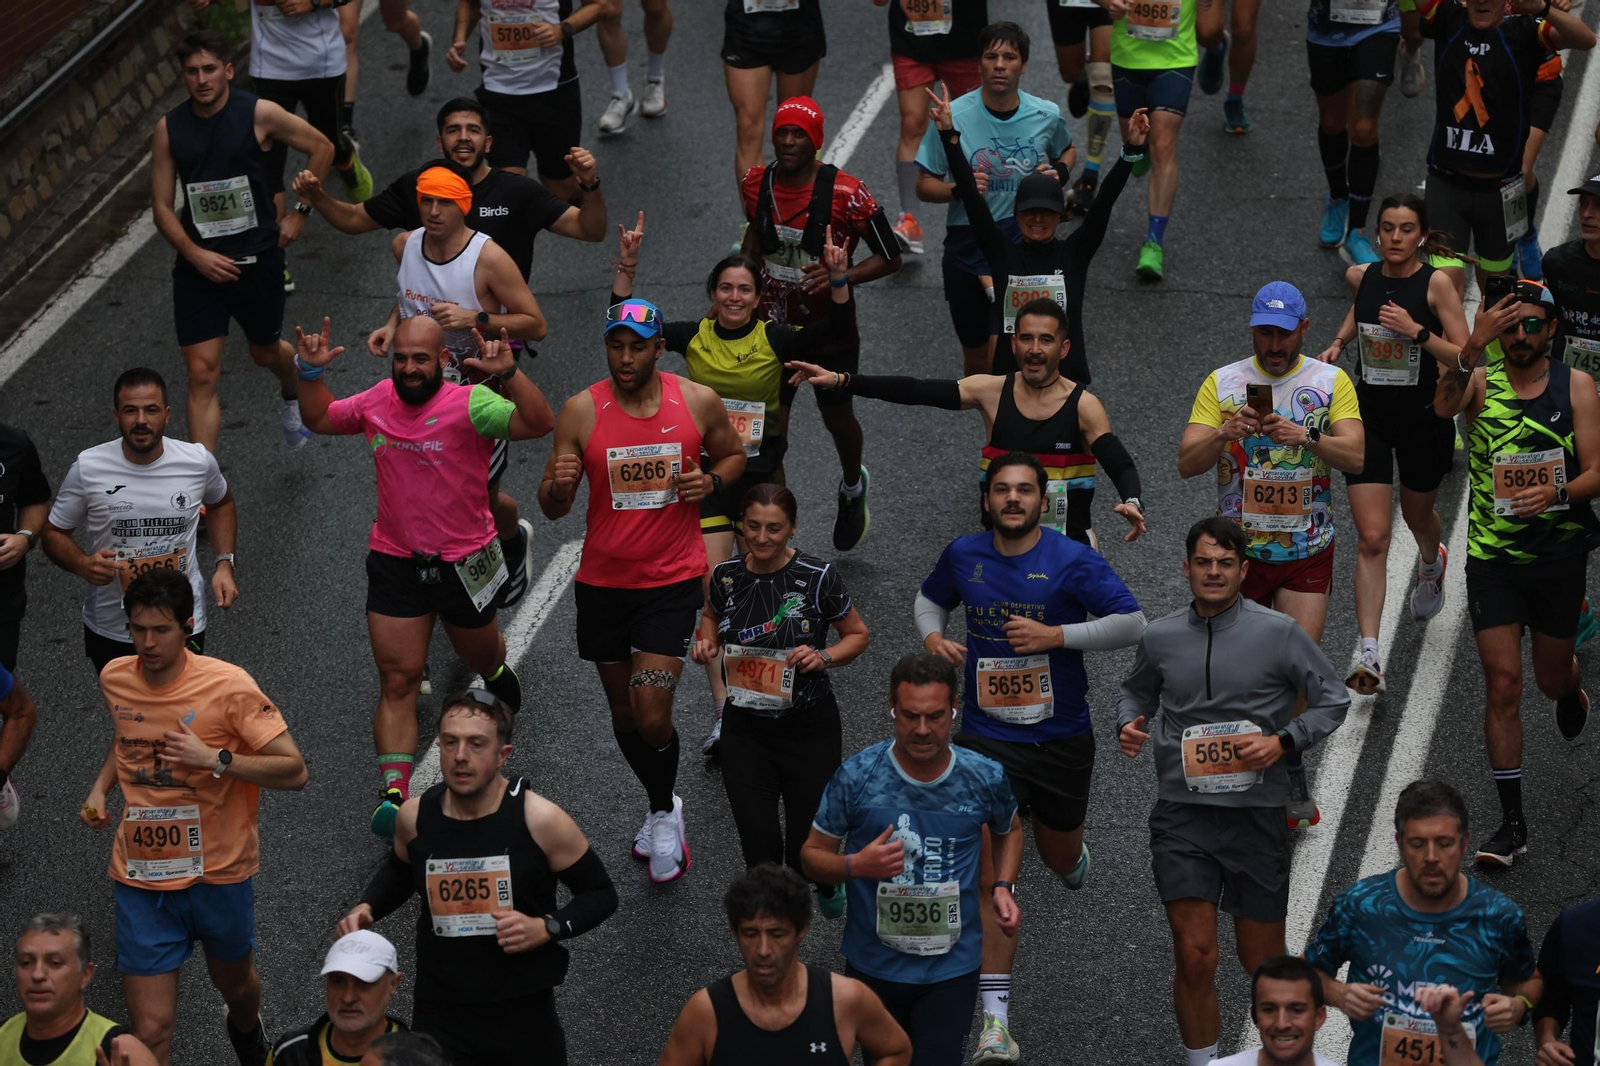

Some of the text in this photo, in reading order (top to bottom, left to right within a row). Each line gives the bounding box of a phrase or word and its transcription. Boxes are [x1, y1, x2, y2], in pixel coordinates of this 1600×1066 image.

[906, 0, 937, 13] 4891
[1134, 3, 1168, 19] 4968
[497, 27, 531, 42] 5780
[1446, 126, 1495, 155] ELA
[199, 193, 238, 213] 9521
[479, 205, 509, 217] Birds
[1365, 339, 1404, 360] 7393
[620, 461, 666, 482] 6266
[1504, 467, 1549, 488] 5826
[1254, 484, 1303, 505] 6213
[111, 528, 141, 537] PUERTO
[117, 517, 185, 527] CLUB ATLETISMO
[1010, 602, 1045, 610] DEPORTIVO
[736, 660, 777, 683] 4971
[988, 674, 1034, 695] 5655
[133, 825, 181, 847] 4390
[439, 878, 490, 902] 6265
[889, 901, 941, 923] 9536
[1394, 1036, 1446, 1065] 451
